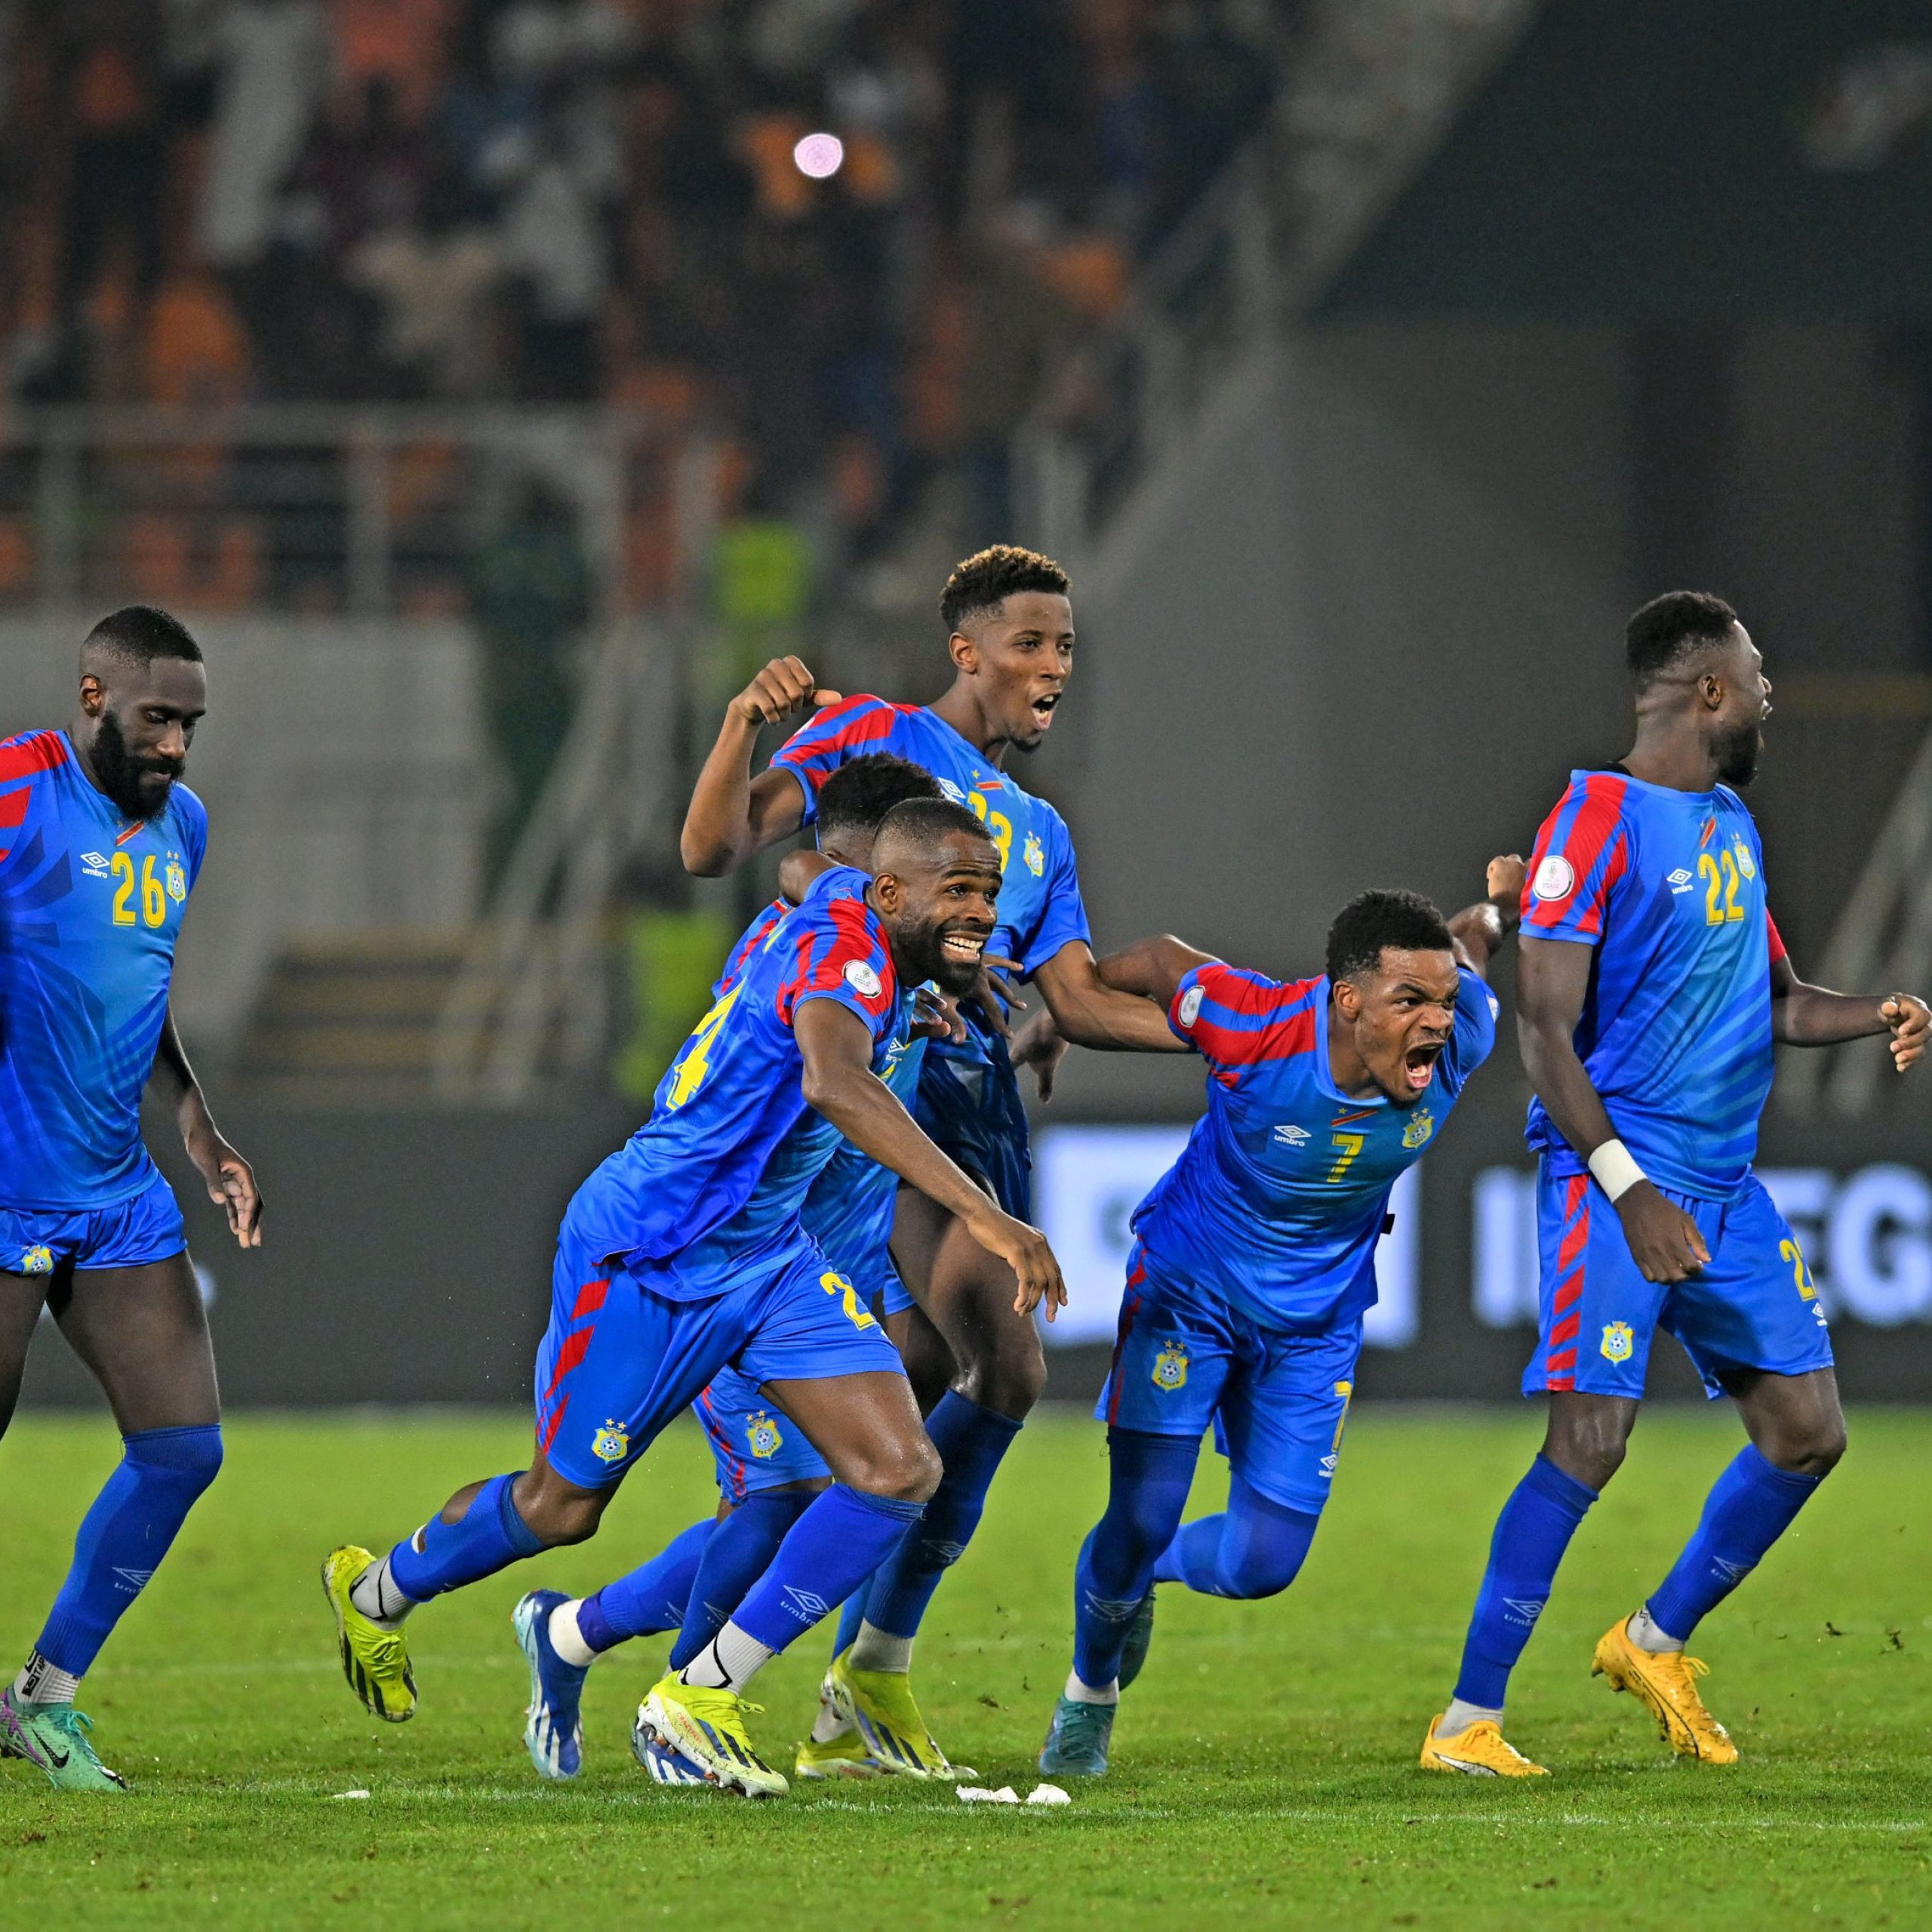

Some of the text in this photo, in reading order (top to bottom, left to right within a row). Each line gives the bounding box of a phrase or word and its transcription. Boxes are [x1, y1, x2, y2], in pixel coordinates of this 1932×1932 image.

[82, 867, 108, 879] umbro
[111, 851, 166, 929] 26
[1697, 850, 1744, 926] 22
[1274, 1134, 1305, 1147] umbro
[1326, 1134, 1364, 1183] 7
[1778, 1236, 1817, 1303] 2
